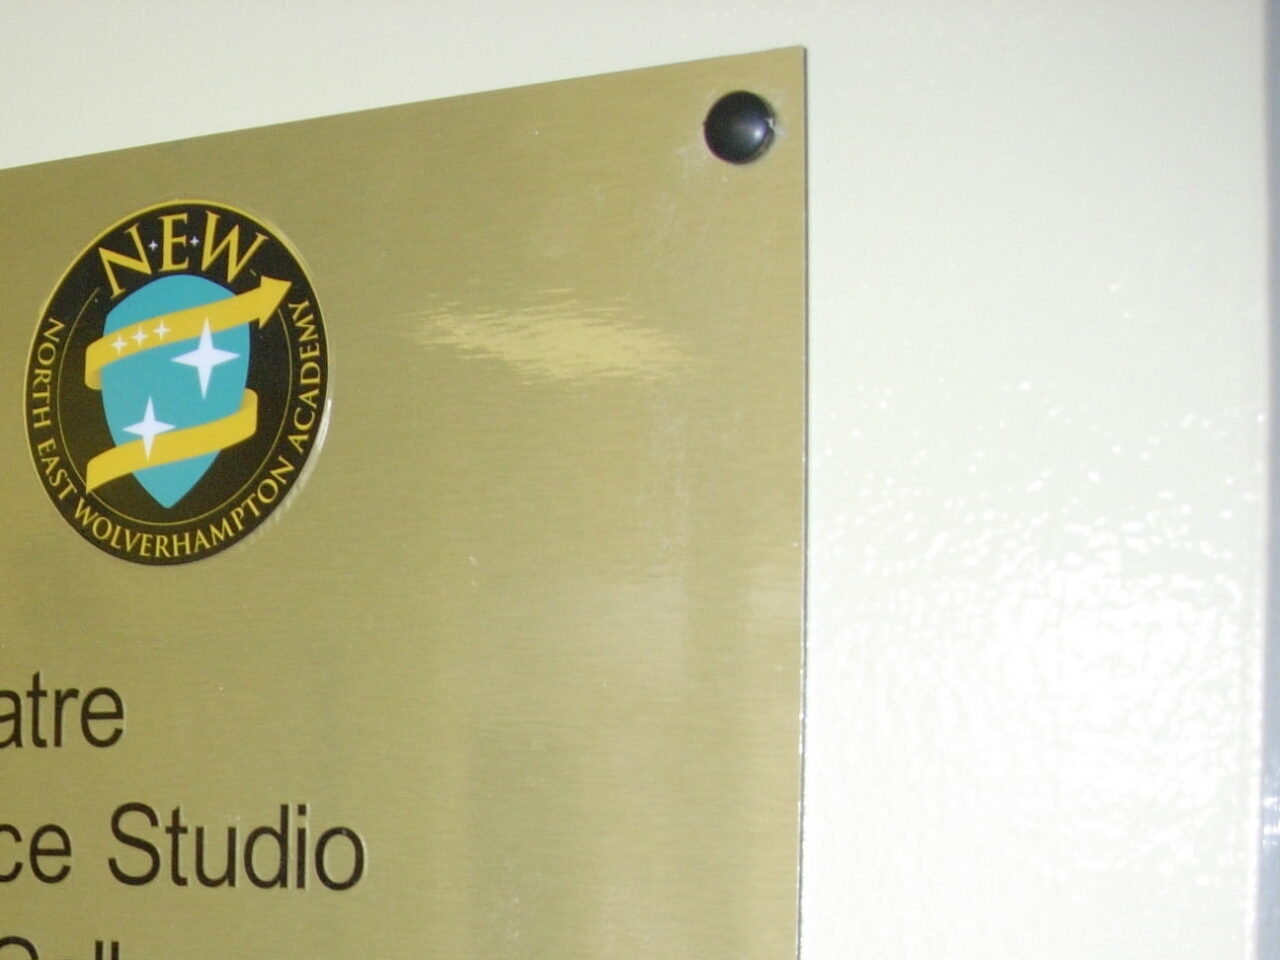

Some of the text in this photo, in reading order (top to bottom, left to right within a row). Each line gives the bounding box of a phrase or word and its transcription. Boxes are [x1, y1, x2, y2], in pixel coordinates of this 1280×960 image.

[32, 300, 321, 558] NORTH EAST WOLVERHAMPTON ACADEMY
[107, 802, 366, 892] Studio
